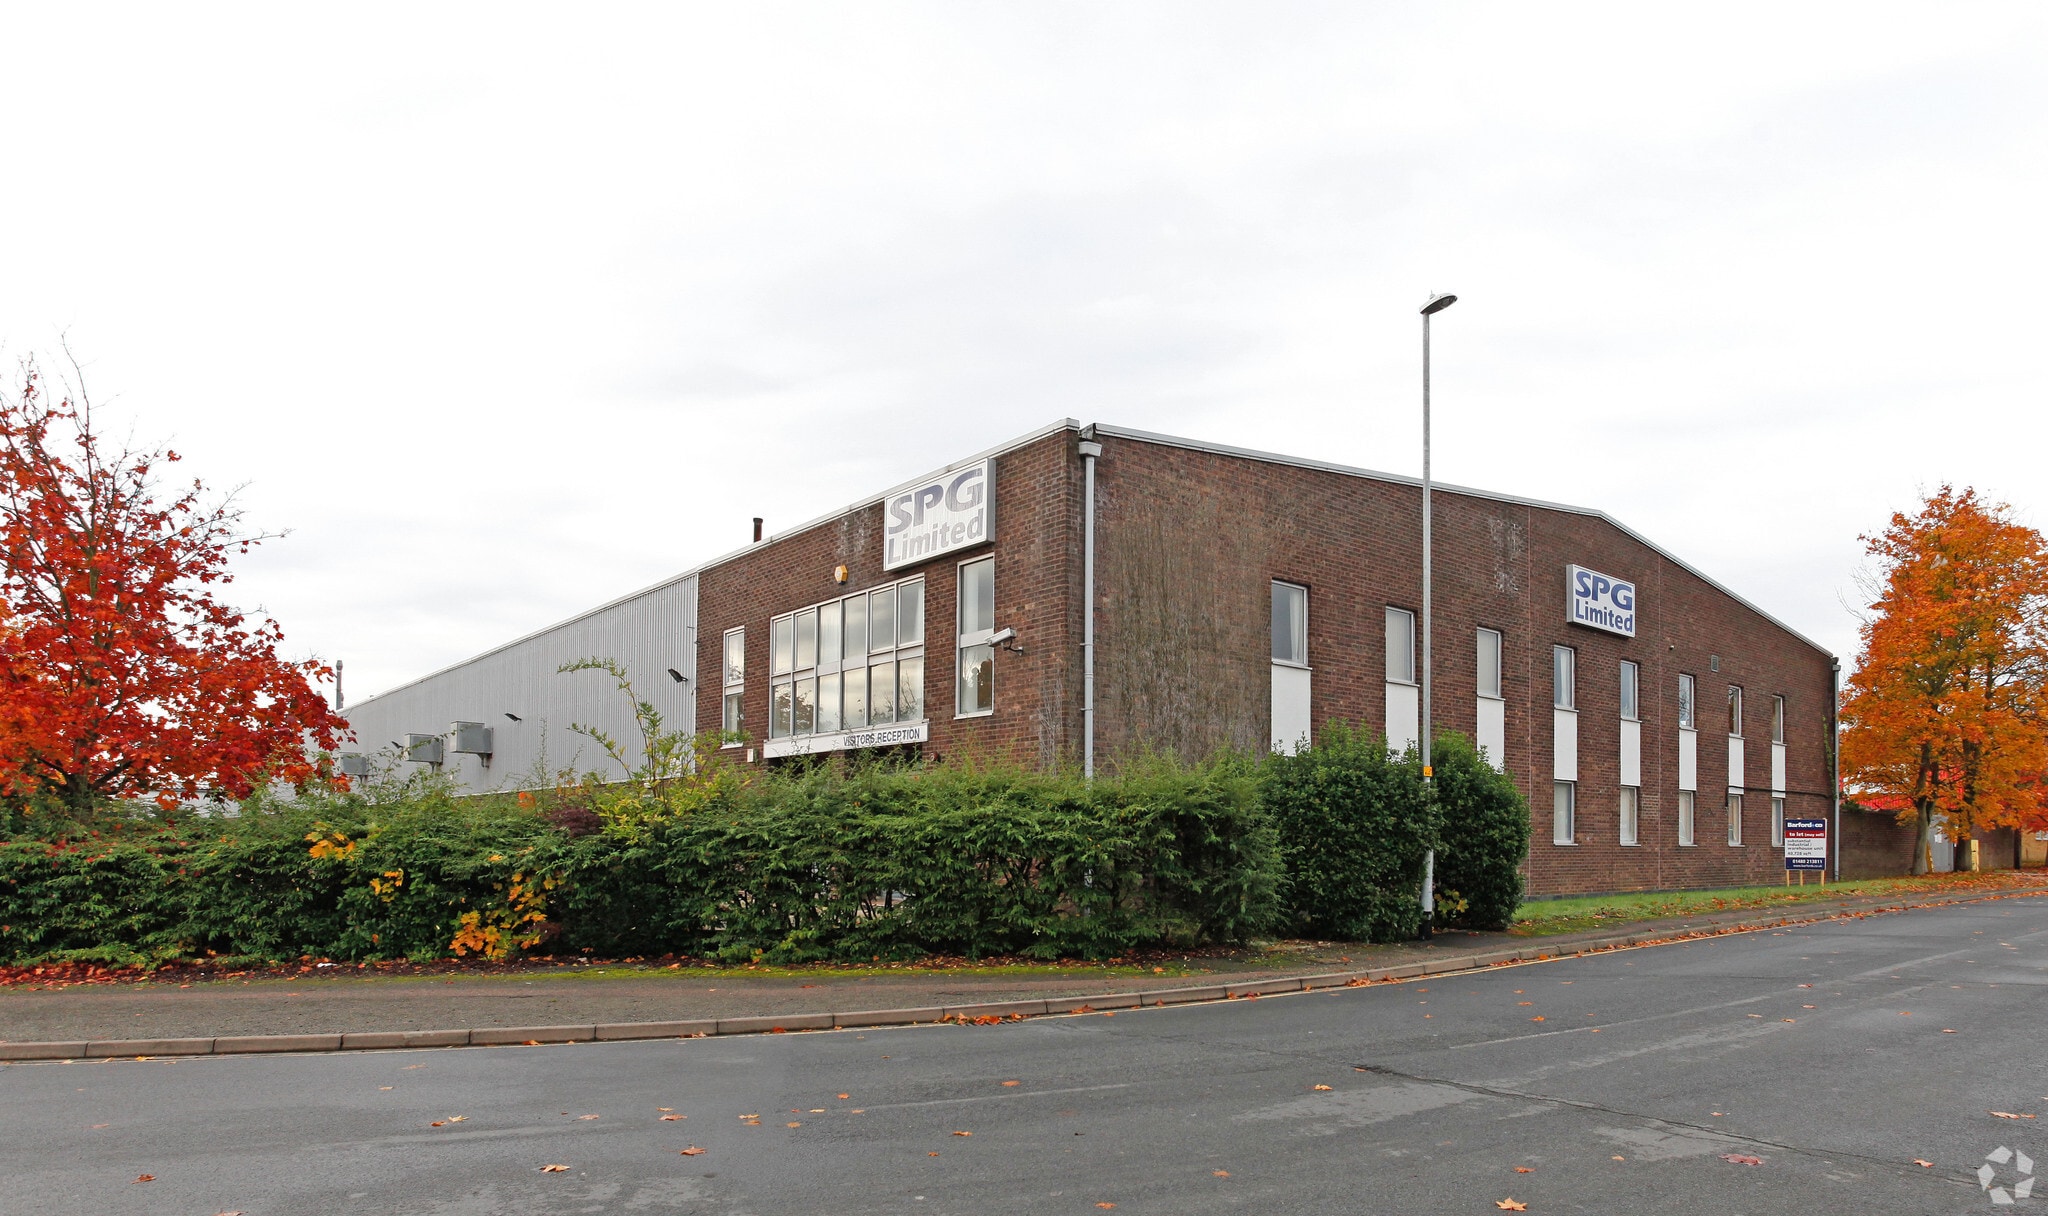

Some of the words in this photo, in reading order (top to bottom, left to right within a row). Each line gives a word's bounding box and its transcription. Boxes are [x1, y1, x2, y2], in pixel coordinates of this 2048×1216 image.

[888, 467, 984, 535] SPG
[888, 507, 984, 565] Limited
[1575, 571, 1632, 611] SPG
[1575, 598, 1633, 632] Limited
[843, 733, 875, 747] VISITORS
[877, 728, 920, 743] RECEPTION
